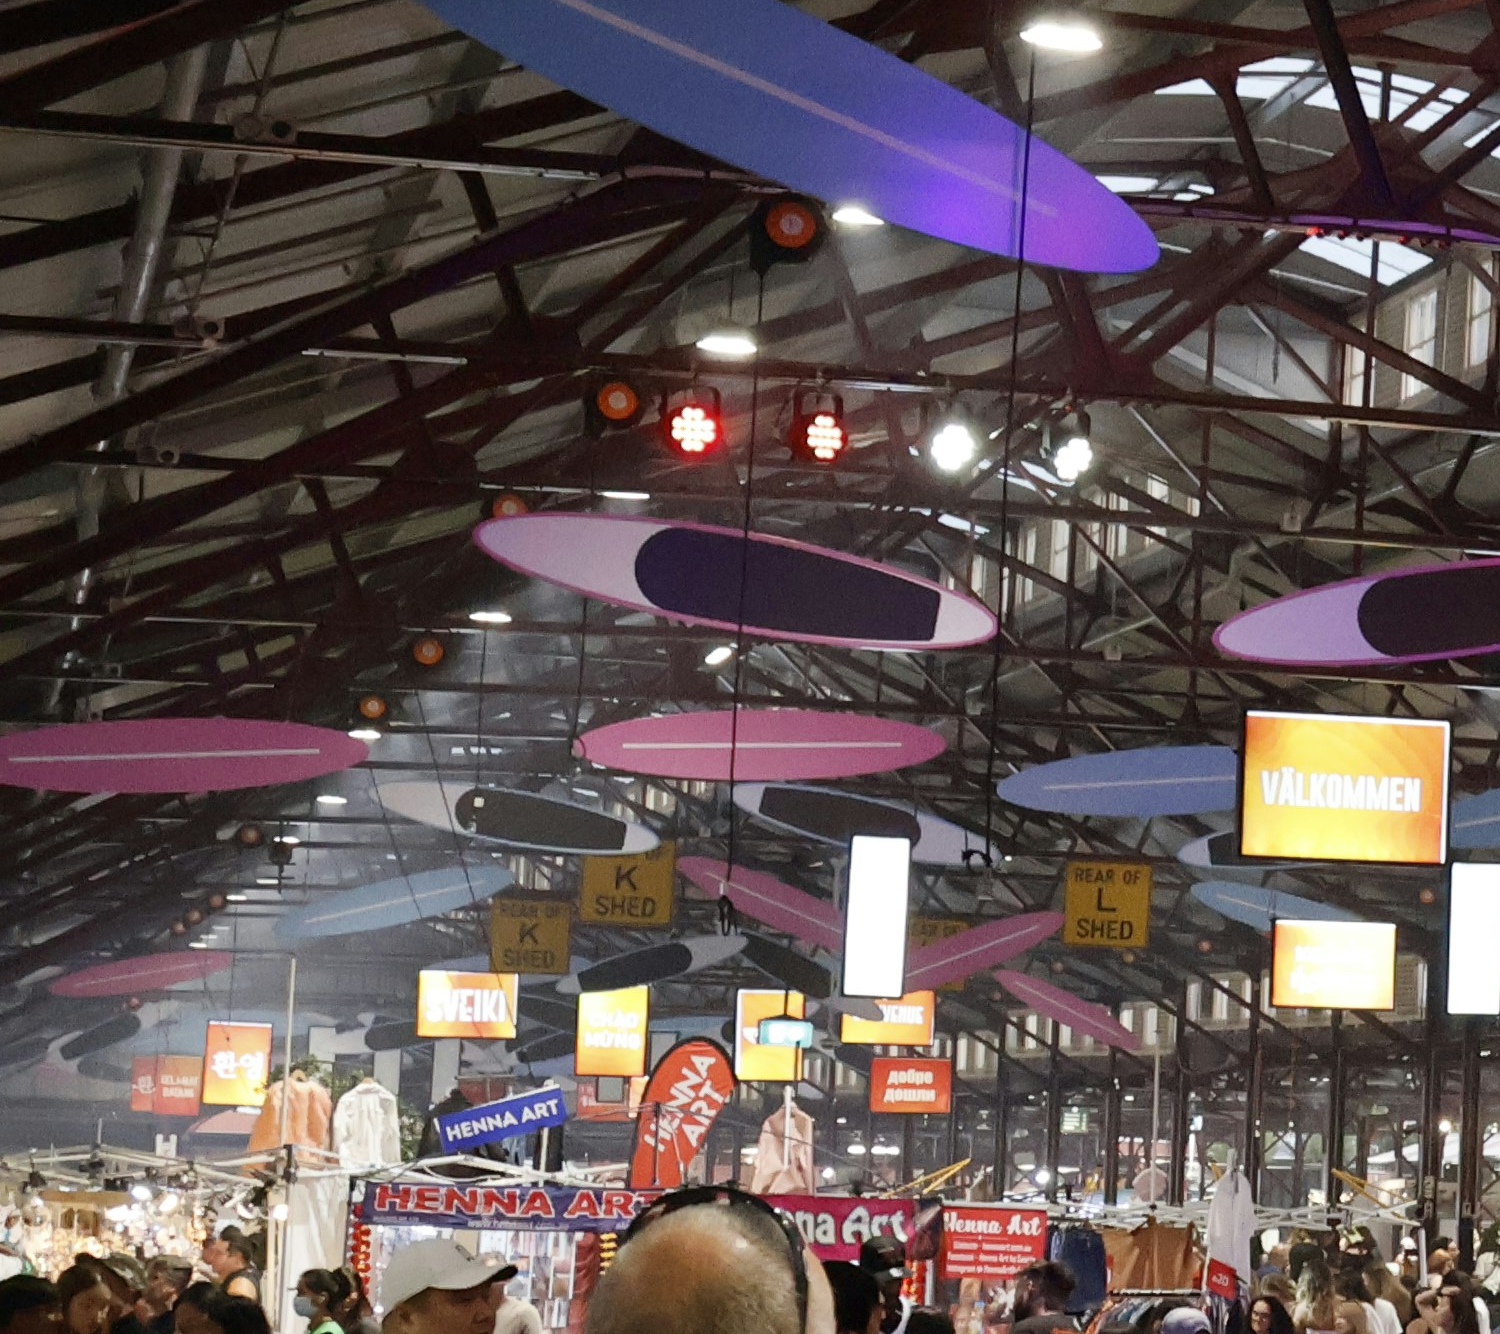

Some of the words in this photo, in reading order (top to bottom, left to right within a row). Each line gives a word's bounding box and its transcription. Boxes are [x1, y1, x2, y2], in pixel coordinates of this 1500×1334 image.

[1261, 770, 1421, 812] VÄLKOMMEN
[615, 864, 638, 891] K
[1074, 867, 1115, 885] REAR
[1122, 869, 1141, 886] OF
[595, 896, 656, 918] SHED
[1096, 888, 1117, 913] L
[519, 923, 539, 946] K
[1075, 917, 1134, 941] SHED
[502, 949, 555, 968] SHED
[425, 989, 507, 1022] SVEIKI
[643, 1053, 716, 1152] HENNA
[680, 1080, 726, 1148] ART
[445, 1109, 520, 1142] HENNA
[521, 1098, 560, 1123] ART
[374, 1183, 556, 1217] HENNA
[842, 1205, 909, 1245] Art
[943, 1211, 1003, 1235] Henna
[1006, 1214, 1042, 1236] Art
